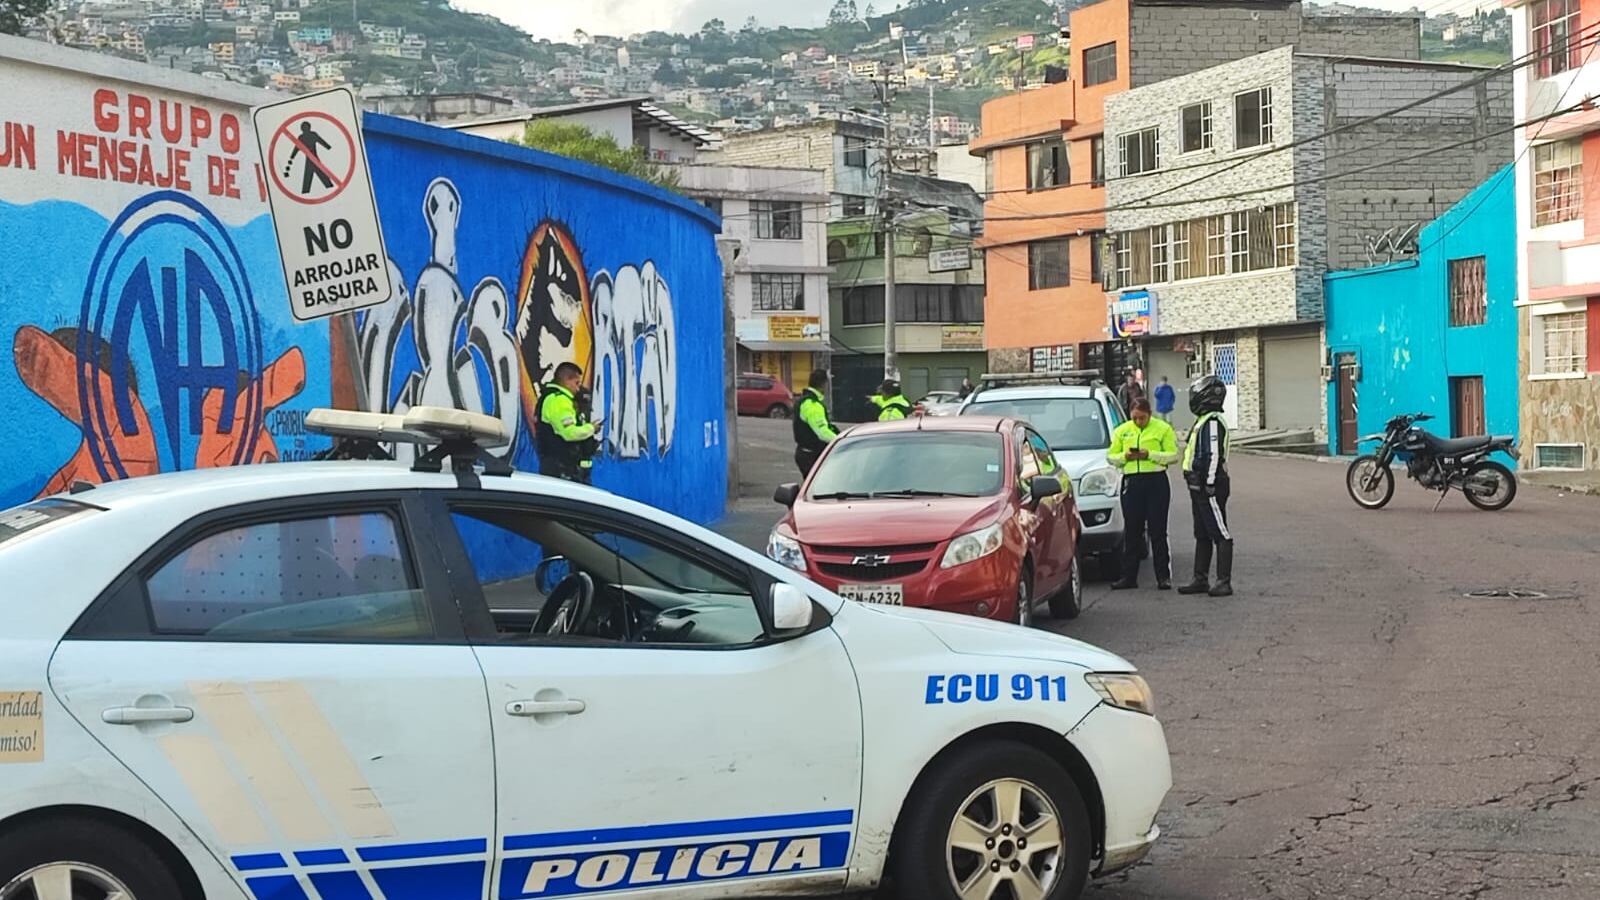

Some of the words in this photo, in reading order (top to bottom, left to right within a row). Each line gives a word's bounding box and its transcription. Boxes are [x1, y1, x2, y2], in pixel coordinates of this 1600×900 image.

[94, 89, 240, 154] GRUPO
[57, 130, 191, 191] MENSAJE
[208, 155, 241, 199] DE
[303, 218, 353, 256] NO
[293, 253, 380, 287] ARROJAR
[304, 277, 378, 308] BASURA
[925, 674, 999, 704] ECU
[1011, 674, 1066, 702] 911
[522, 837, 821, 894] POLICIA
